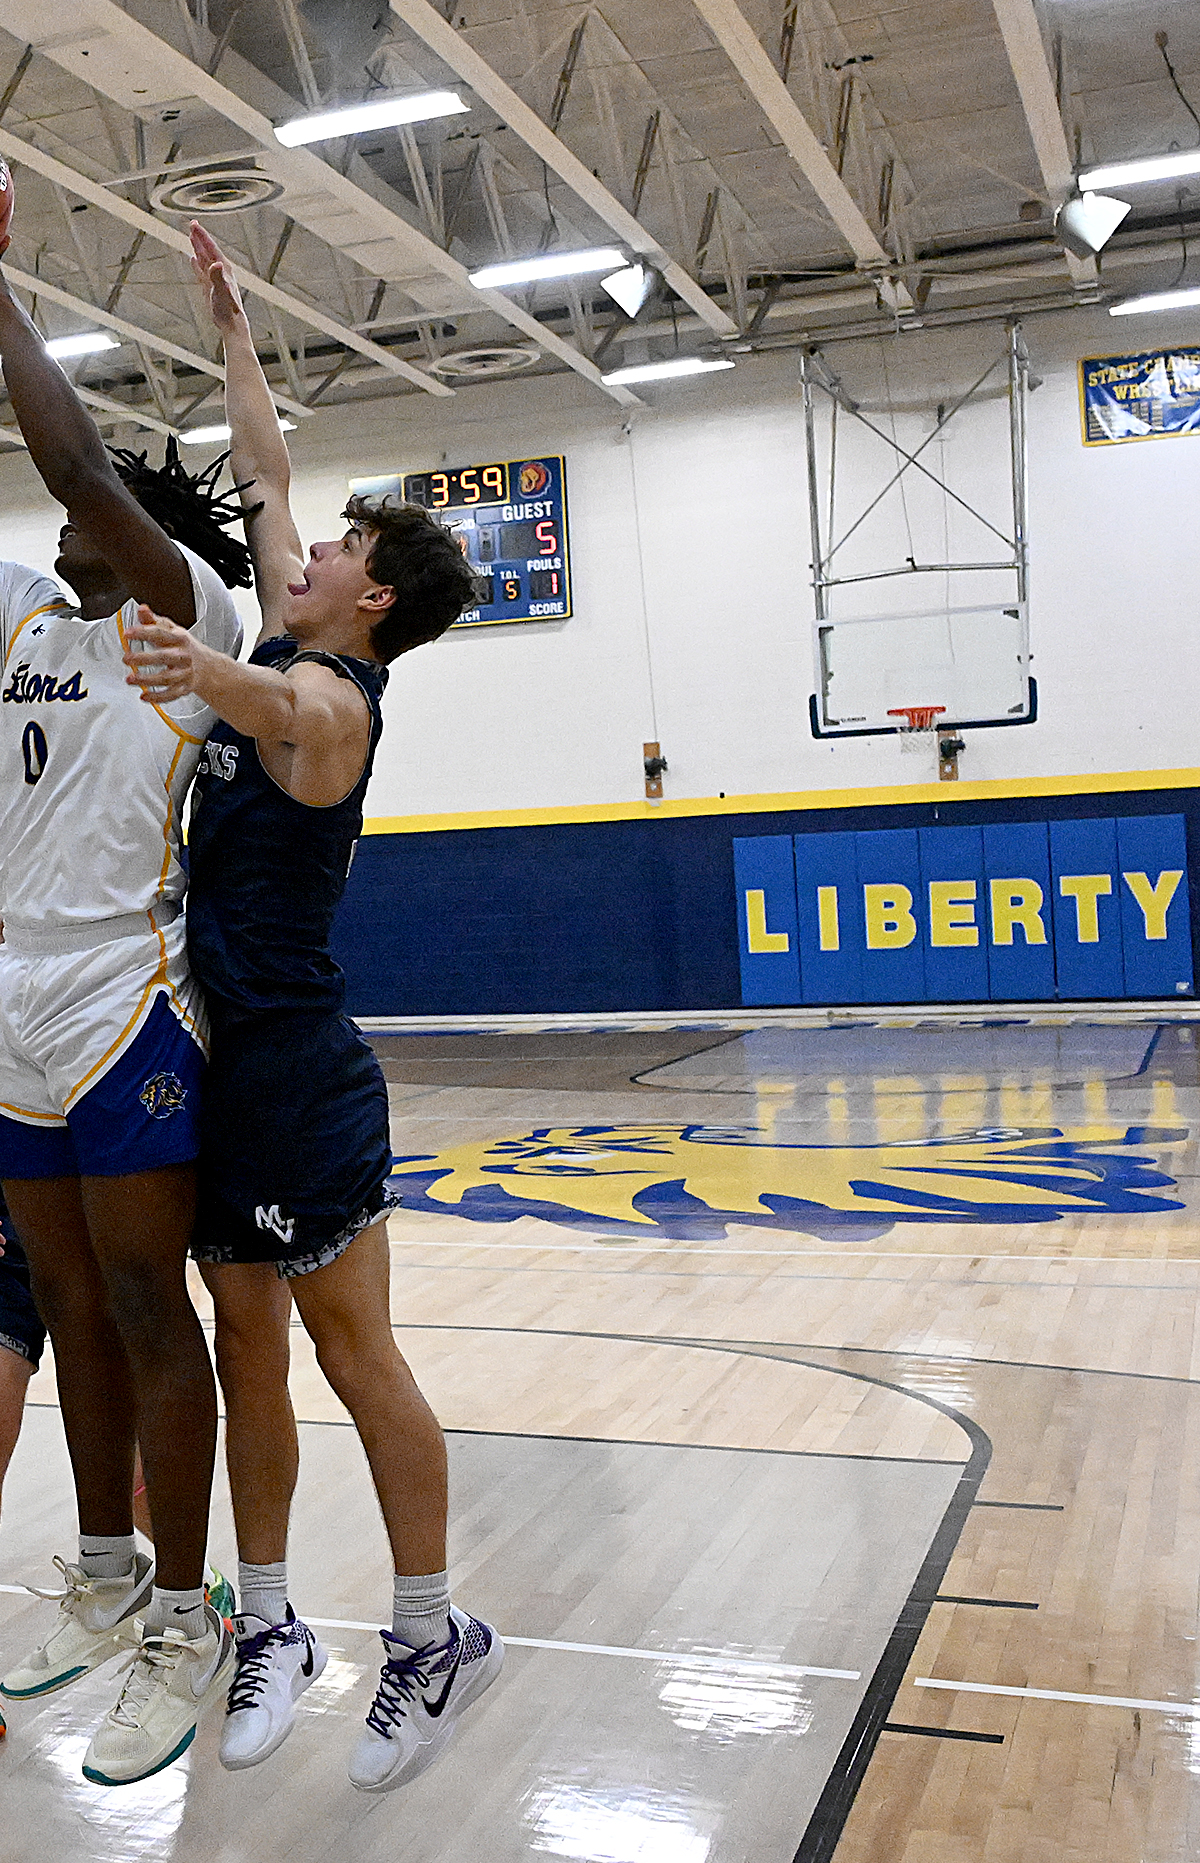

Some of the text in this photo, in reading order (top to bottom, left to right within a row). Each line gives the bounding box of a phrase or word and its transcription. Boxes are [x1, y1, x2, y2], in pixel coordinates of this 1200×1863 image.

[503, 501, 553, 521] GUEST
[536, 521, 557, 555] 5
[527, 558, 562, 572] FOULS
[505, 581, 518, 600] 5
[551, 573, 559, 595] 1
[529, 602, 564, 616] SCORE
[22, 721, 49, 786] 0
[746, 870, 1185, 953] LIBERTY
